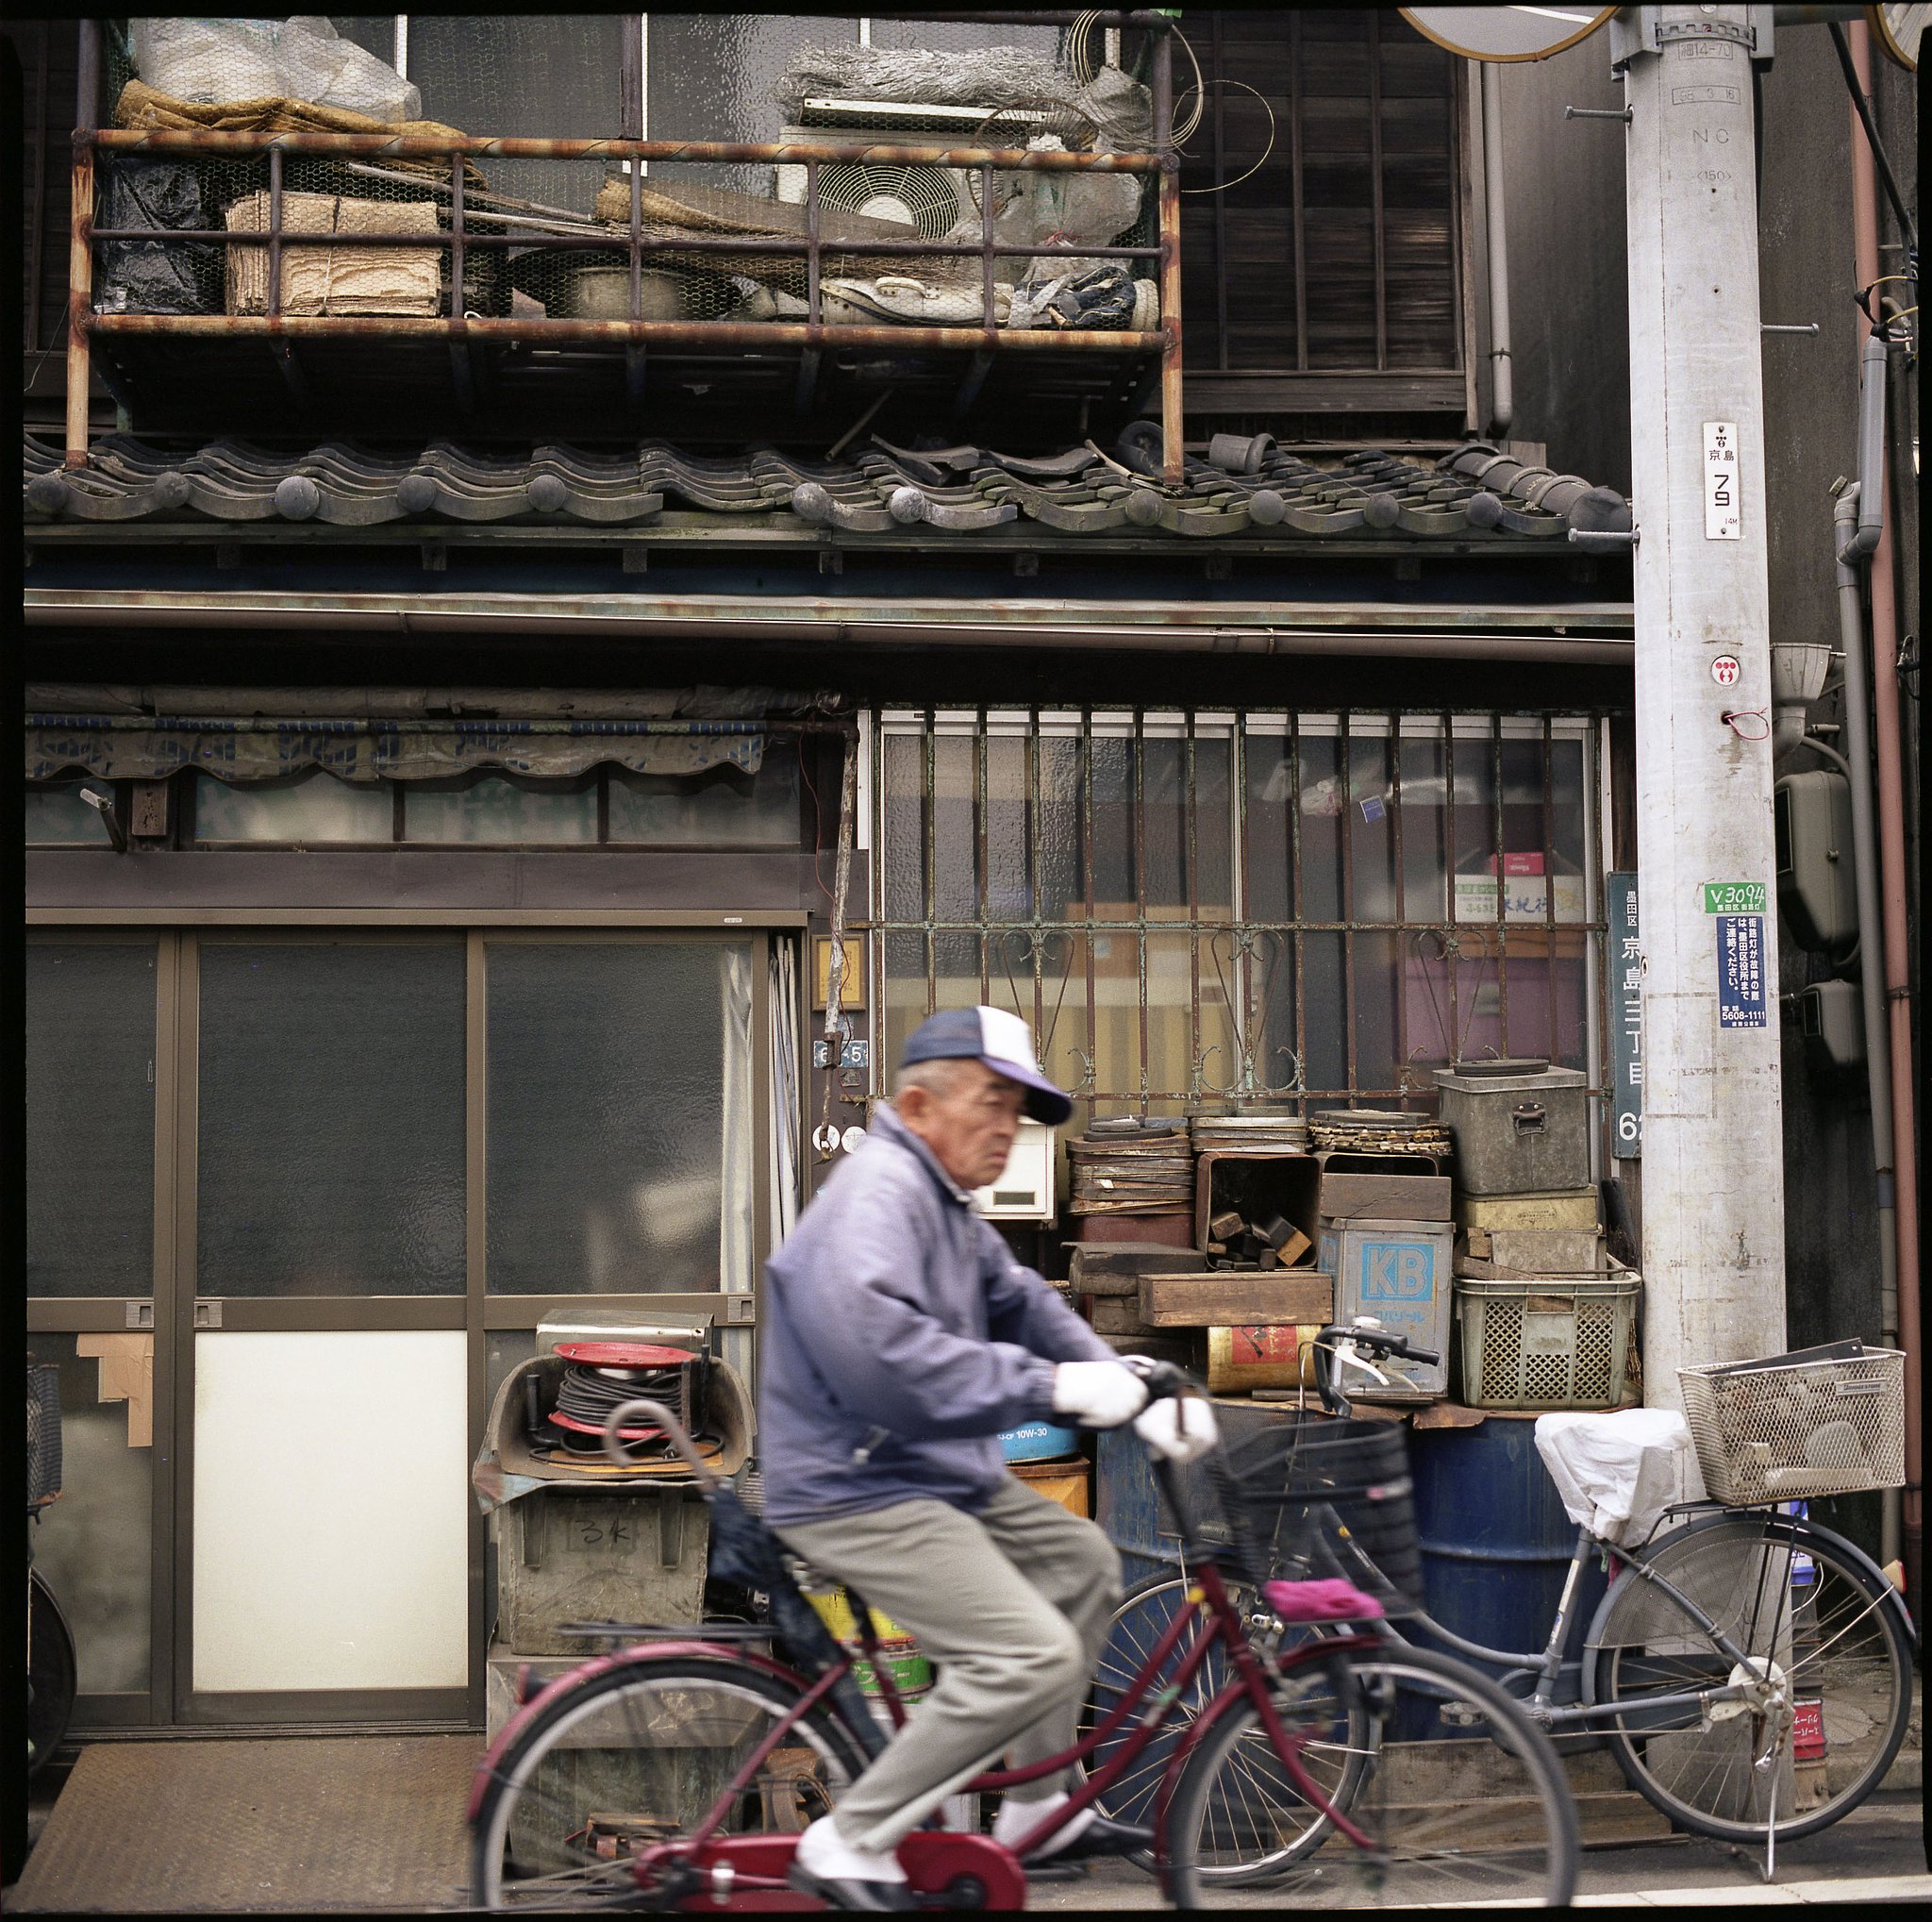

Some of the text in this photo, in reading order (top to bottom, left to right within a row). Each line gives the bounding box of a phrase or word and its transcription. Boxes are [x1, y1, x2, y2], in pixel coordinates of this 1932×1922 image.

[1708, 449, 1734, 461] 京島
[1714, 474, 1730, 507] 79
[1626, 891, 1638, 927] 墨田区
[1622, 935, 1641, 1085] 京島三丁目
[1722, 1011, 1765, 1020] 5608-1111
[1368, 1246, 1428, 1297] KB
[1016, 1428, 1047, 1439] 10W-30
